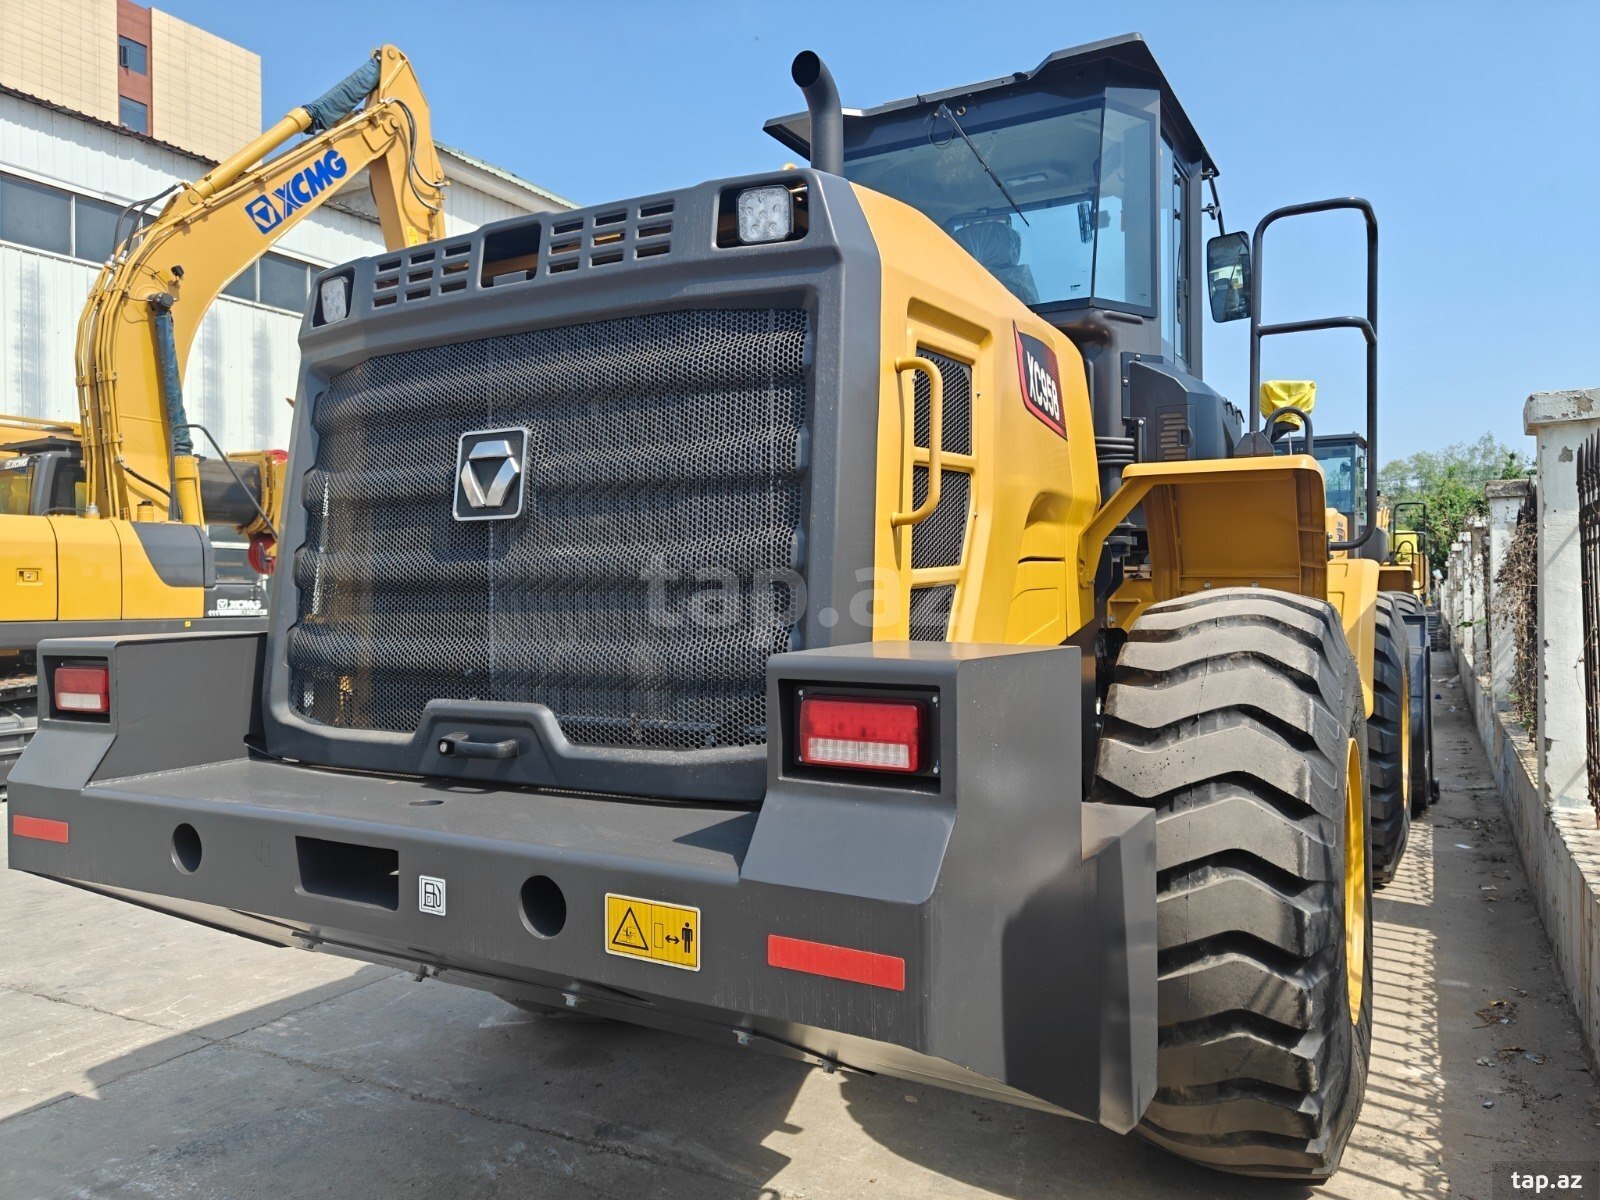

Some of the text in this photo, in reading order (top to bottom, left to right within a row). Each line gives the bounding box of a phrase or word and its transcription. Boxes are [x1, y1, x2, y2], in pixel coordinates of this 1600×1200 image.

[272, 150, 347, 220] XCMG
[1026, 350, 1060, 422] XC958
[228, 599, 262, 610] XCMG
